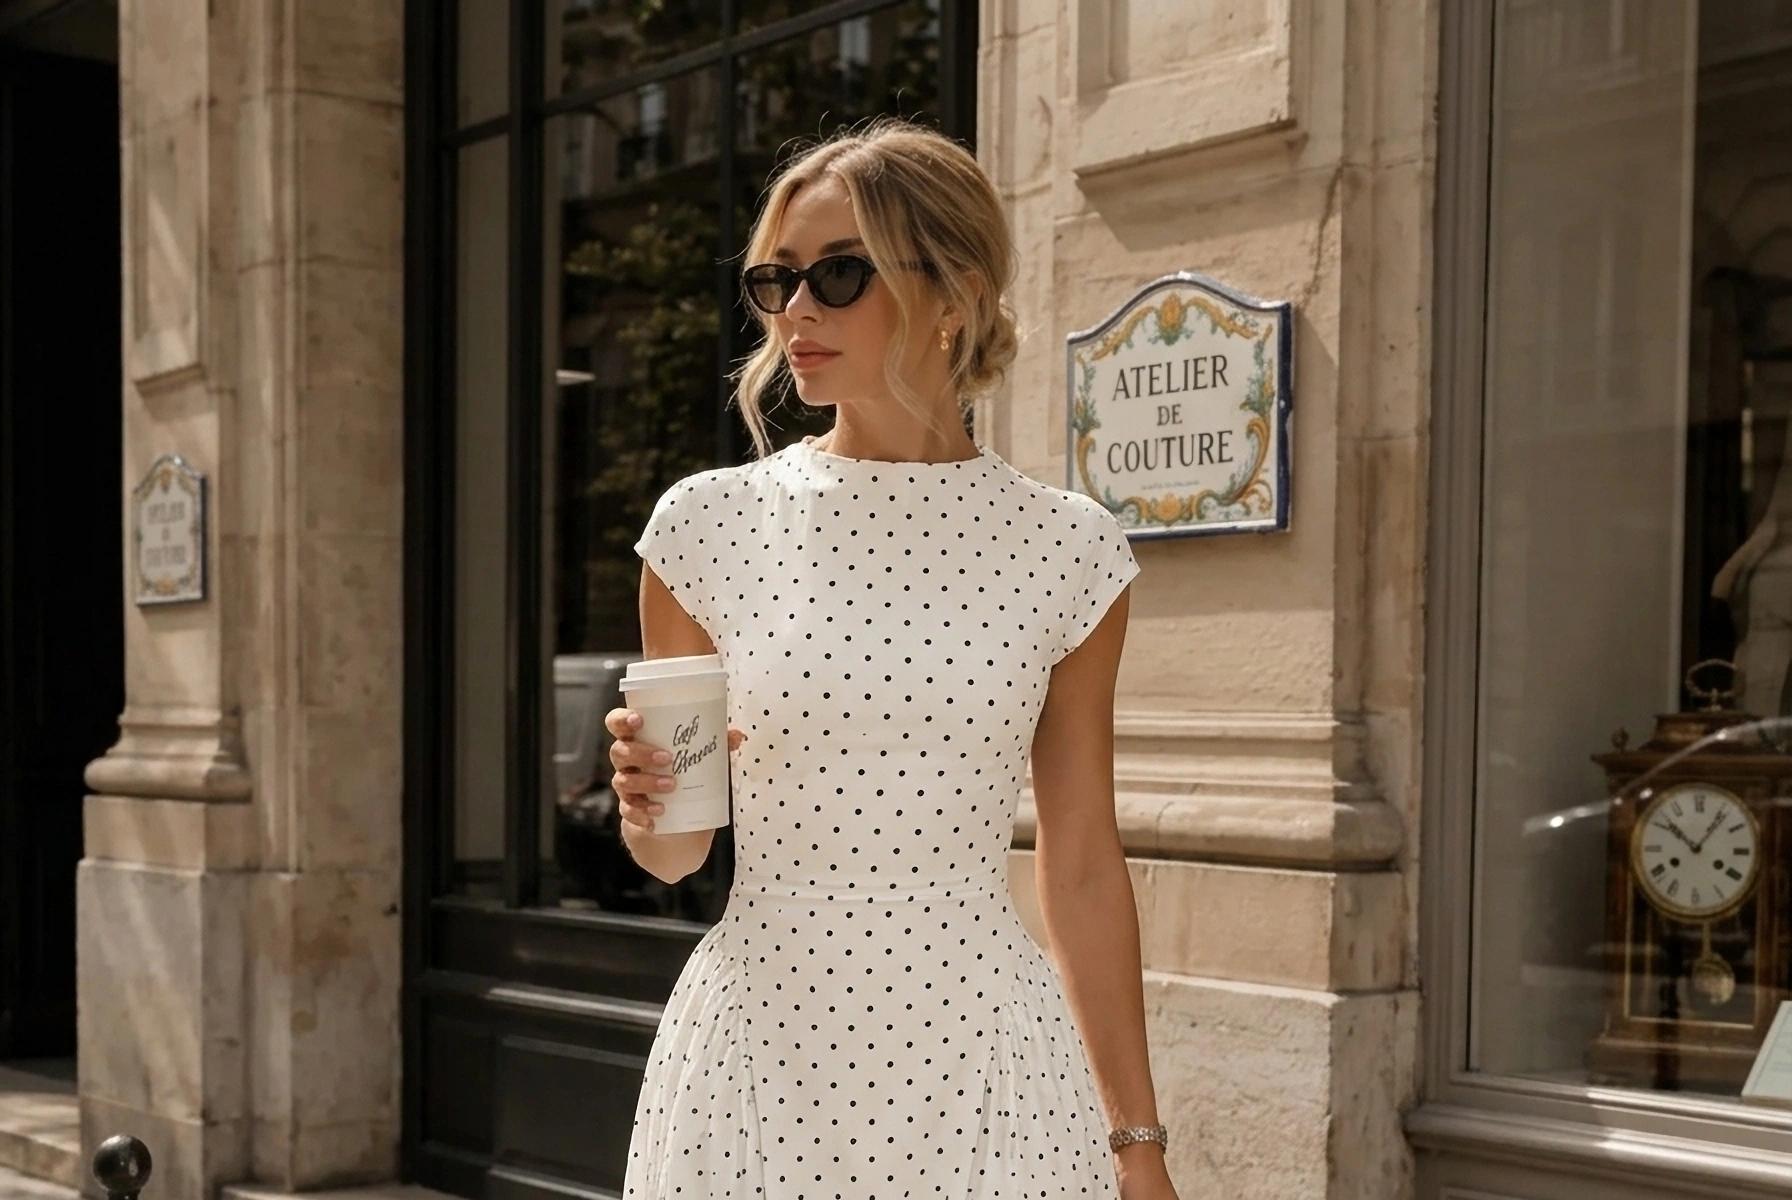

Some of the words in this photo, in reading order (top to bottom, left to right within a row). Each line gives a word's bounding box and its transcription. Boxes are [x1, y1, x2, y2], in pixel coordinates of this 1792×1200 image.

[1112, 354, 1229, 401] ATELIER
[1157, 404, 1183, 426] DE
[1107, 430, 1234, 474] COUTURE
